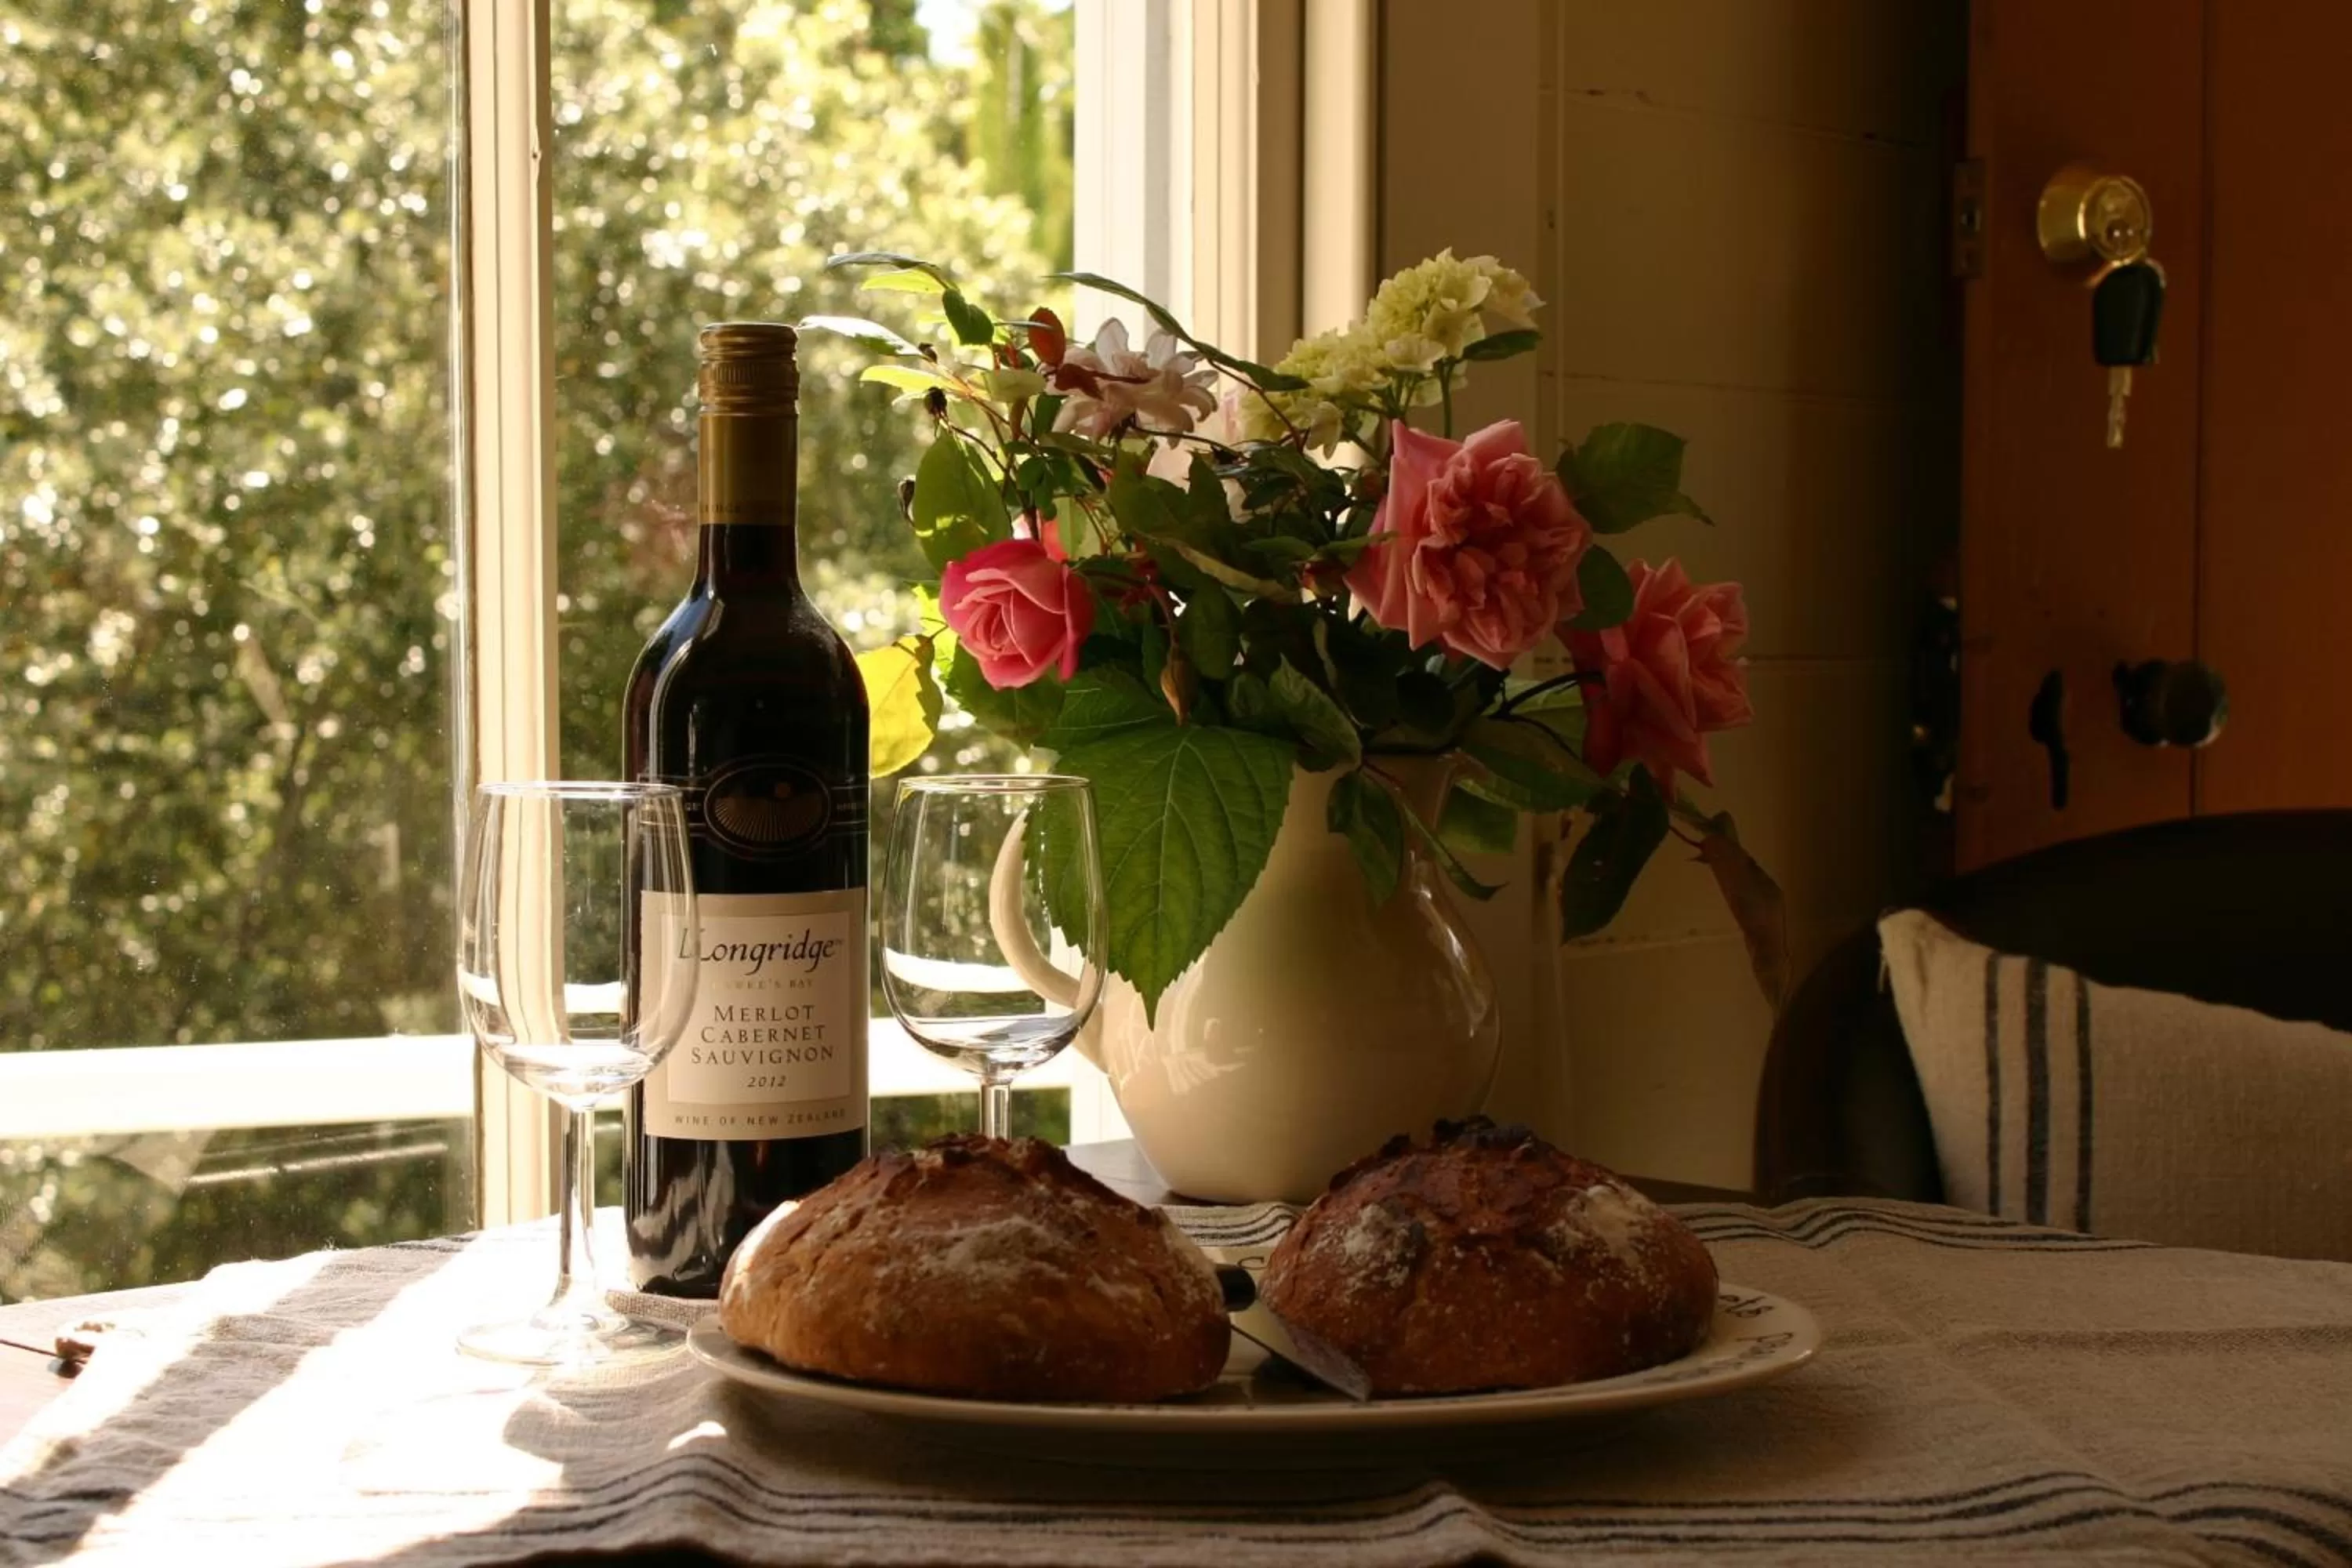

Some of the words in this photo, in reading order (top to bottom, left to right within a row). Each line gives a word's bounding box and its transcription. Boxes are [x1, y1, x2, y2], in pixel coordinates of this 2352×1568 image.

[678, 927, 835, 976] Longridge
[713, 1004, 816, 1023] MERLOT
[701, 1025, 827, 1044] CABERNET
[691, 1044, 835, 1065] SAUVIGNON
[746, 1075, 787, 1088] 2012
[674, 1115, 710, 1126] WINE
[719, 1115, 736, 1127] OF
[746, 1115, 779, 1126] NEW
